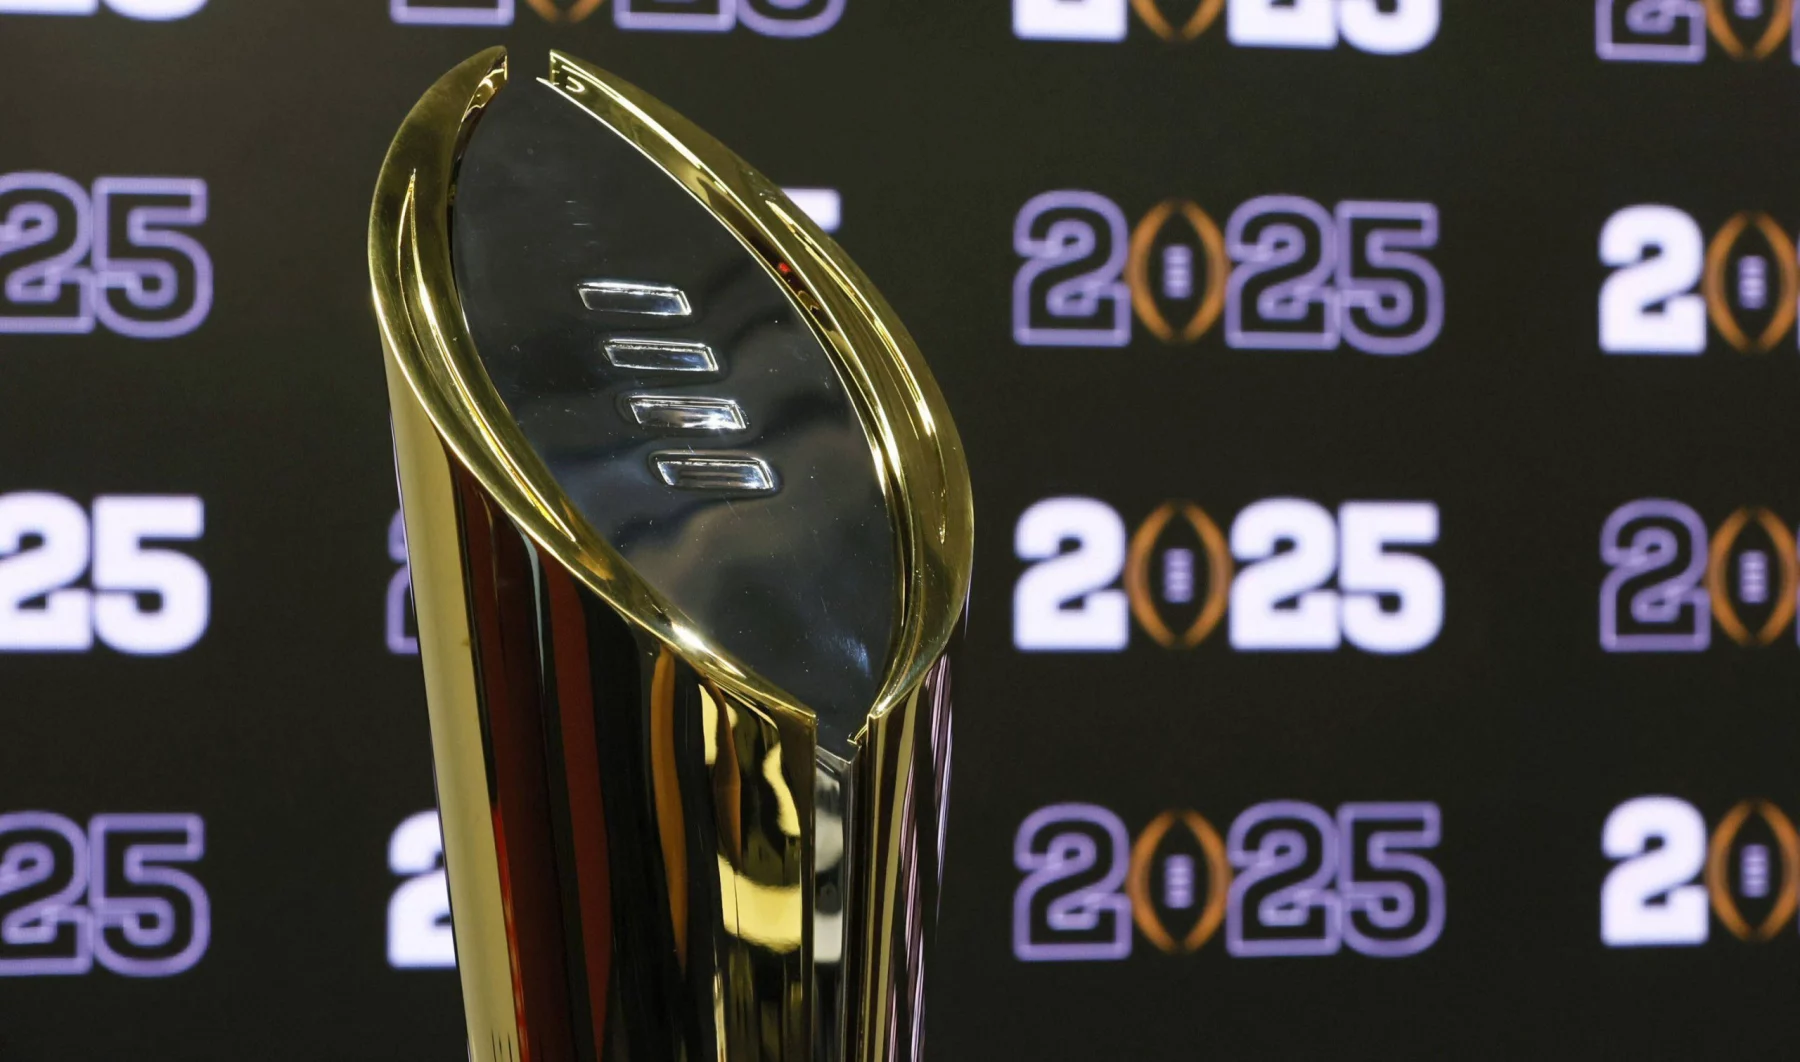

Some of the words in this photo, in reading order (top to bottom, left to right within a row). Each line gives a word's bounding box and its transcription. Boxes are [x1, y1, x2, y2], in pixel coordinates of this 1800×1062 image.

[0, 172, 213, 340] 25
[1598, 203, 1800, 356] 20
[0, 491, 211, 657] 25
[1599, 499, 1800, 652] 20
[0, 811, 211, 977] 25
[1600, 795, 1800, 948] 20
